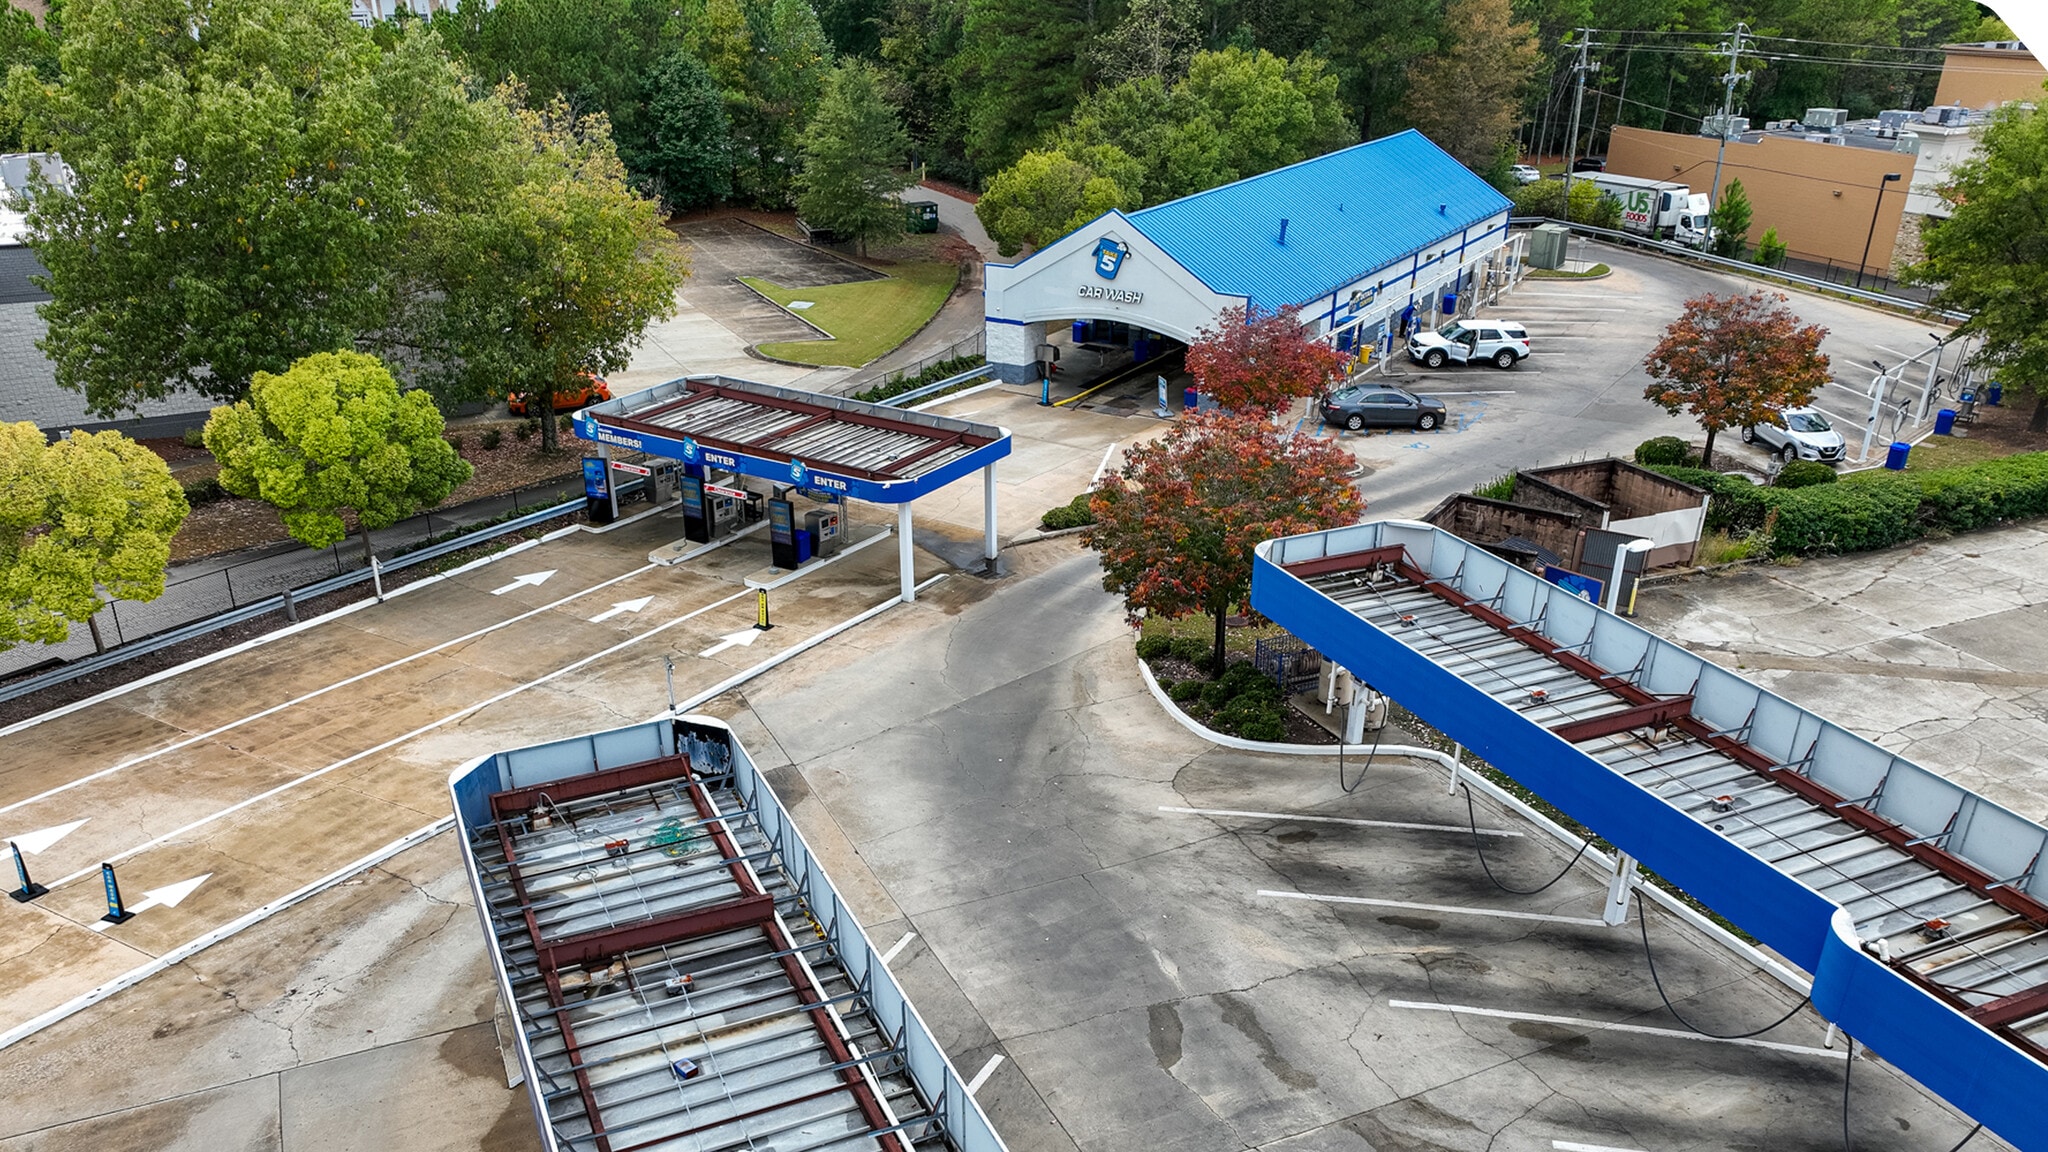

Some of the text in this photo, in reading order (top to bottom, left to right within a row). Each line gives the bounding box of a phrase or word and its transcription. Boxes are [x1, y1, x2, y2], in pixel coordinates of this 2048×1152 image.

[1626, 211, 1647, 222] FOODS
[1103, 249, 1118, 258] TAKE
[1100, 254, 1116, 272] 5
[1078, 285, 1143, 304] CAR WASH
[598, 432, 642, 449] MEMBERS!
[705, 452, 735, 467] ENTER
[814, 475, 847, 491] ENTER
